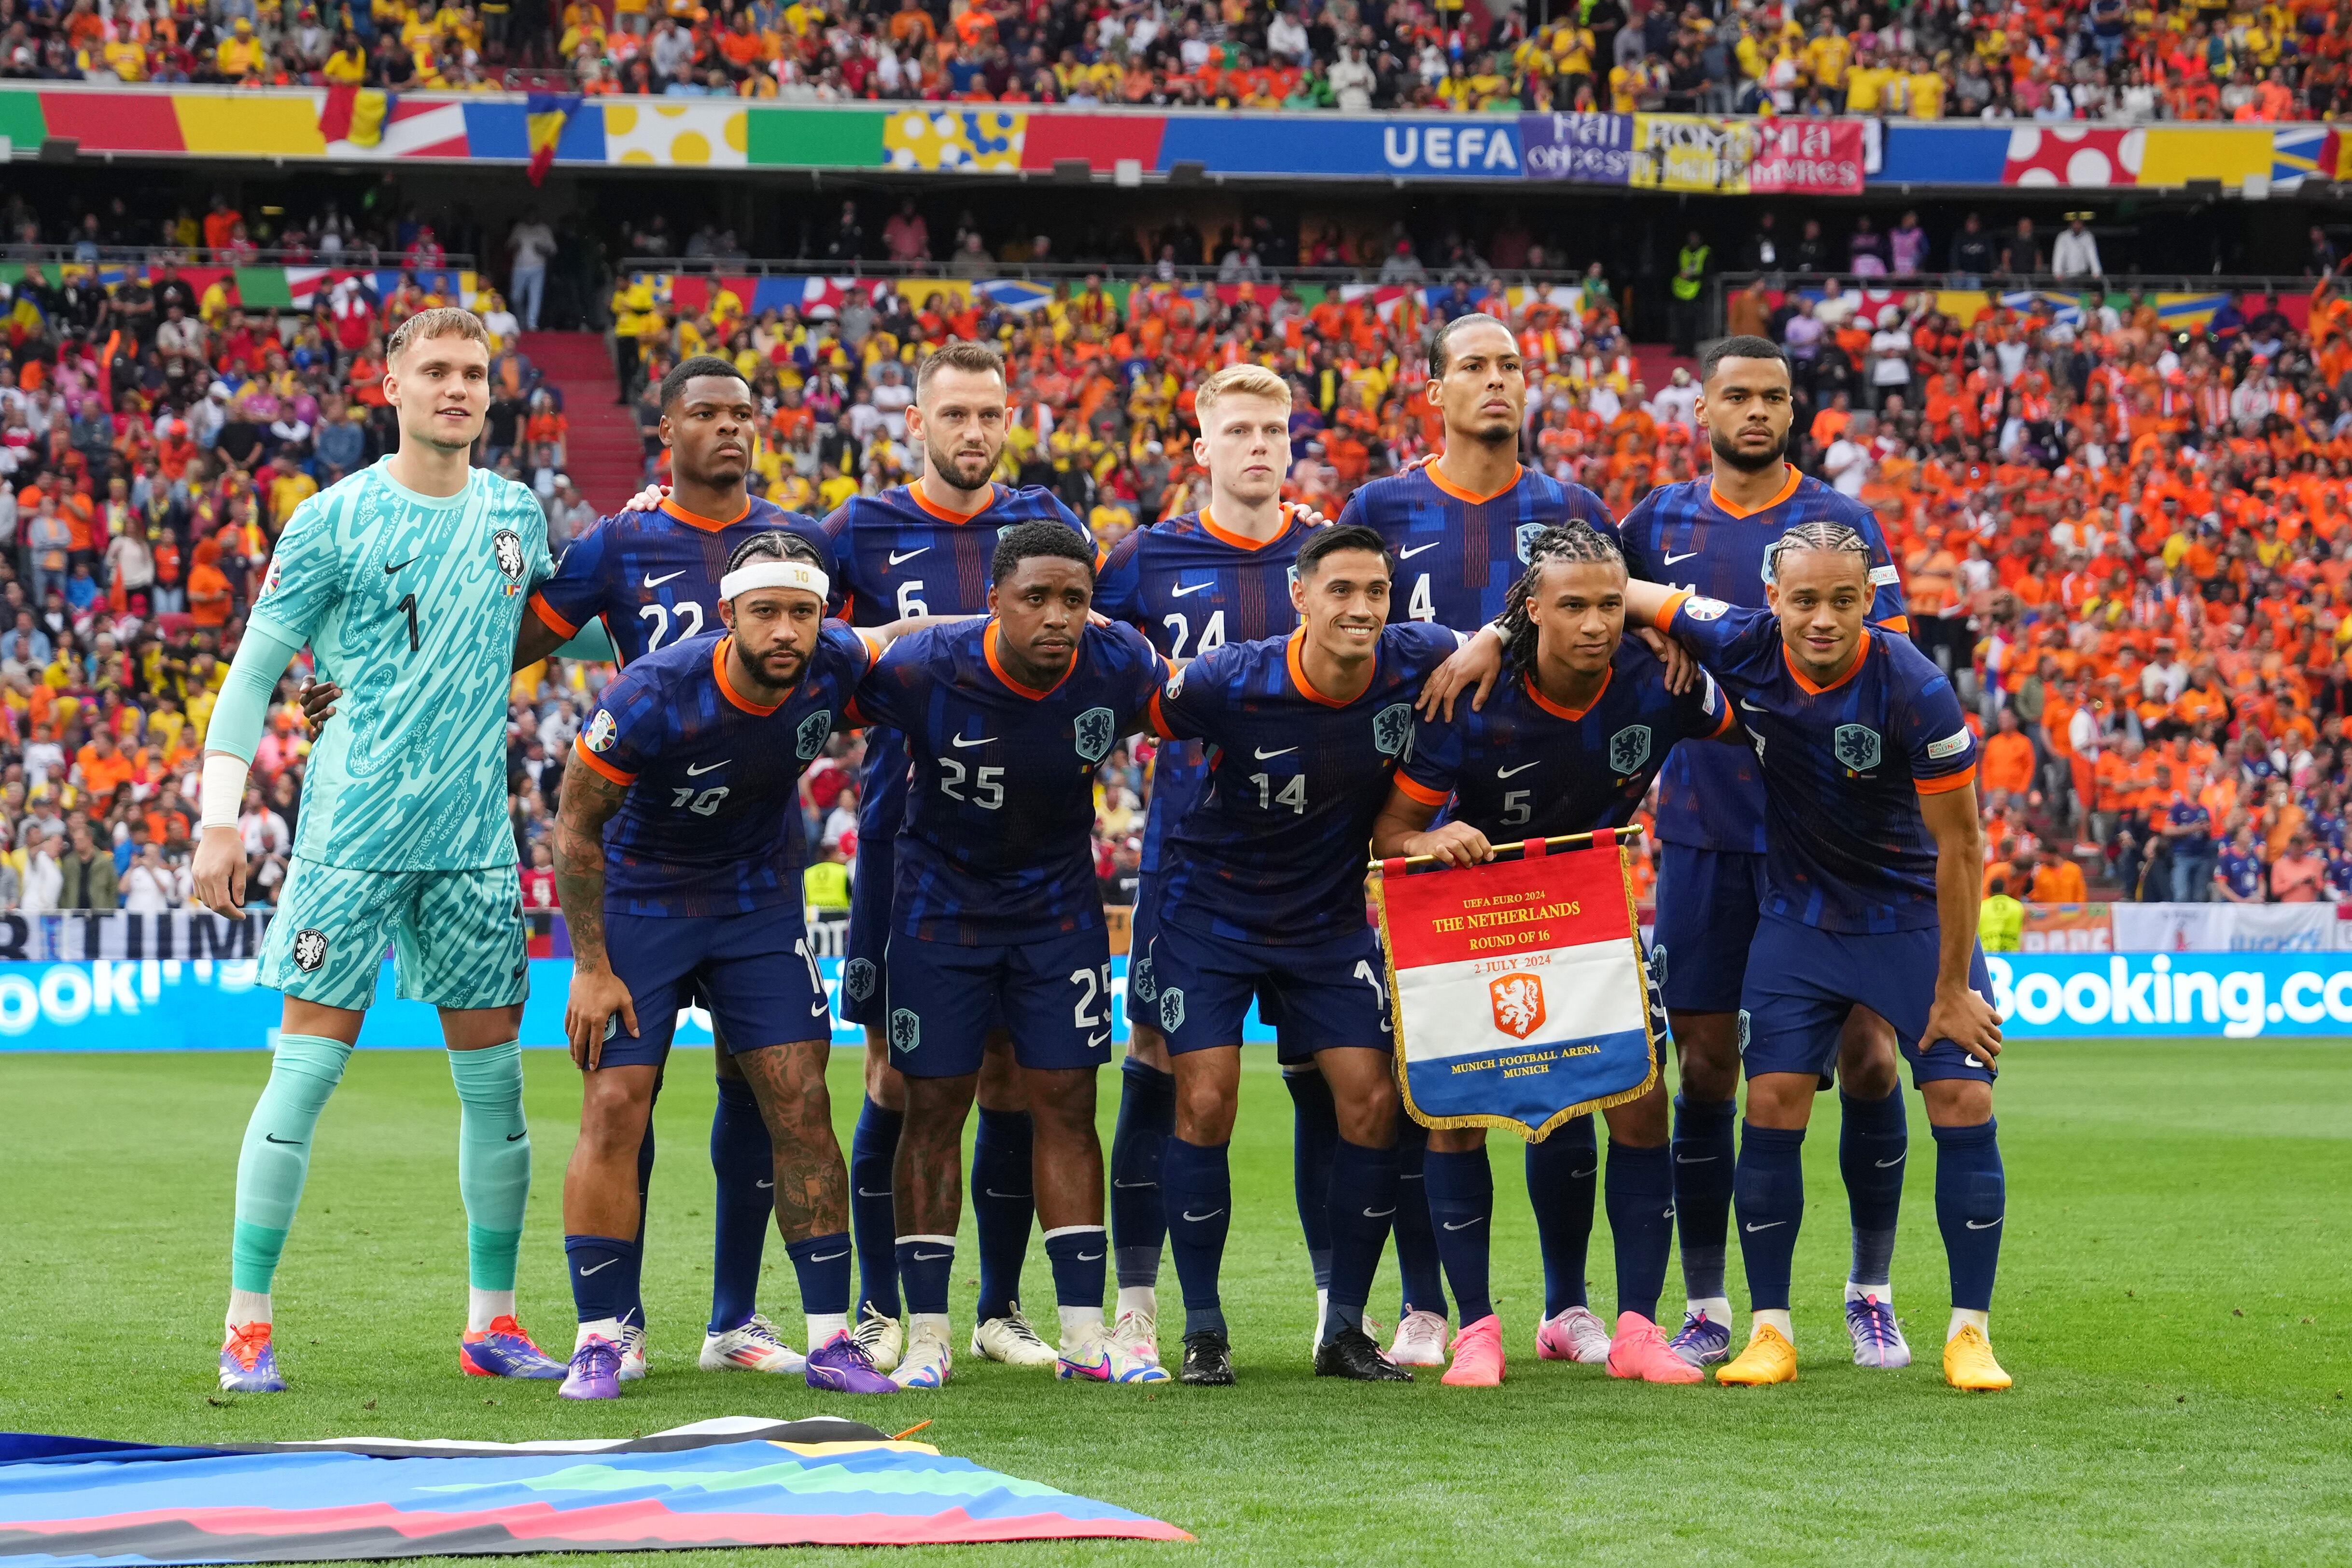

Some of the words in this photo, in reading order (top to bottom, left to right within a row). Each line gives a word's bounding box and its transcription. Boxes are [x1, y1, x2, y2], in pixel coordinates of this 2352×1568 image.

[1384, 126, 1518, 169] UEFA
[794, 569, 809, 584] 10
[897, 580, 928, 620] 6
[1408, 573, 1436, 623] 4
[397, 594, 419, 652] 1
[639, 601, 704, 654] 22
[1163, 610, 1226, 660] 24
[672, 785, 730, 816] 10
[938, 757, 1005, 810] 25
[1249, 772, 1308, 814] 14
[1500, 789, 1531, 825] 5
[1432, 916, 1465, 933] THE
[1467, 901, 1581, 929] NETHERLANDS
[1463, 898, 1491, 909] UEFA
[1492, 894, 1523, 905] EURO
[1525, 890, 1545, 901] 2024
[1469, 934, 1515, 951] ROUND
[1518, 931, 1536, 944] OF
[1538, 929, 1550, 941] 16
[795, 937, 827, 994] 1
[1474, 964, 1481, 974] 2
[1486, 959, 1518, 972] JULY
[1525, 954, 1551, 967] 2024
[1985, 953, 2352, 1038] Booking.co
[1451, 1059, 1496, 1074] MUNICH
[1499, 1050, 1558, 1067] FOOTBALL
[1561, 1044, 1601, 1058] ARENA
[1503, 1064, 1550, 1078] MUNICH
